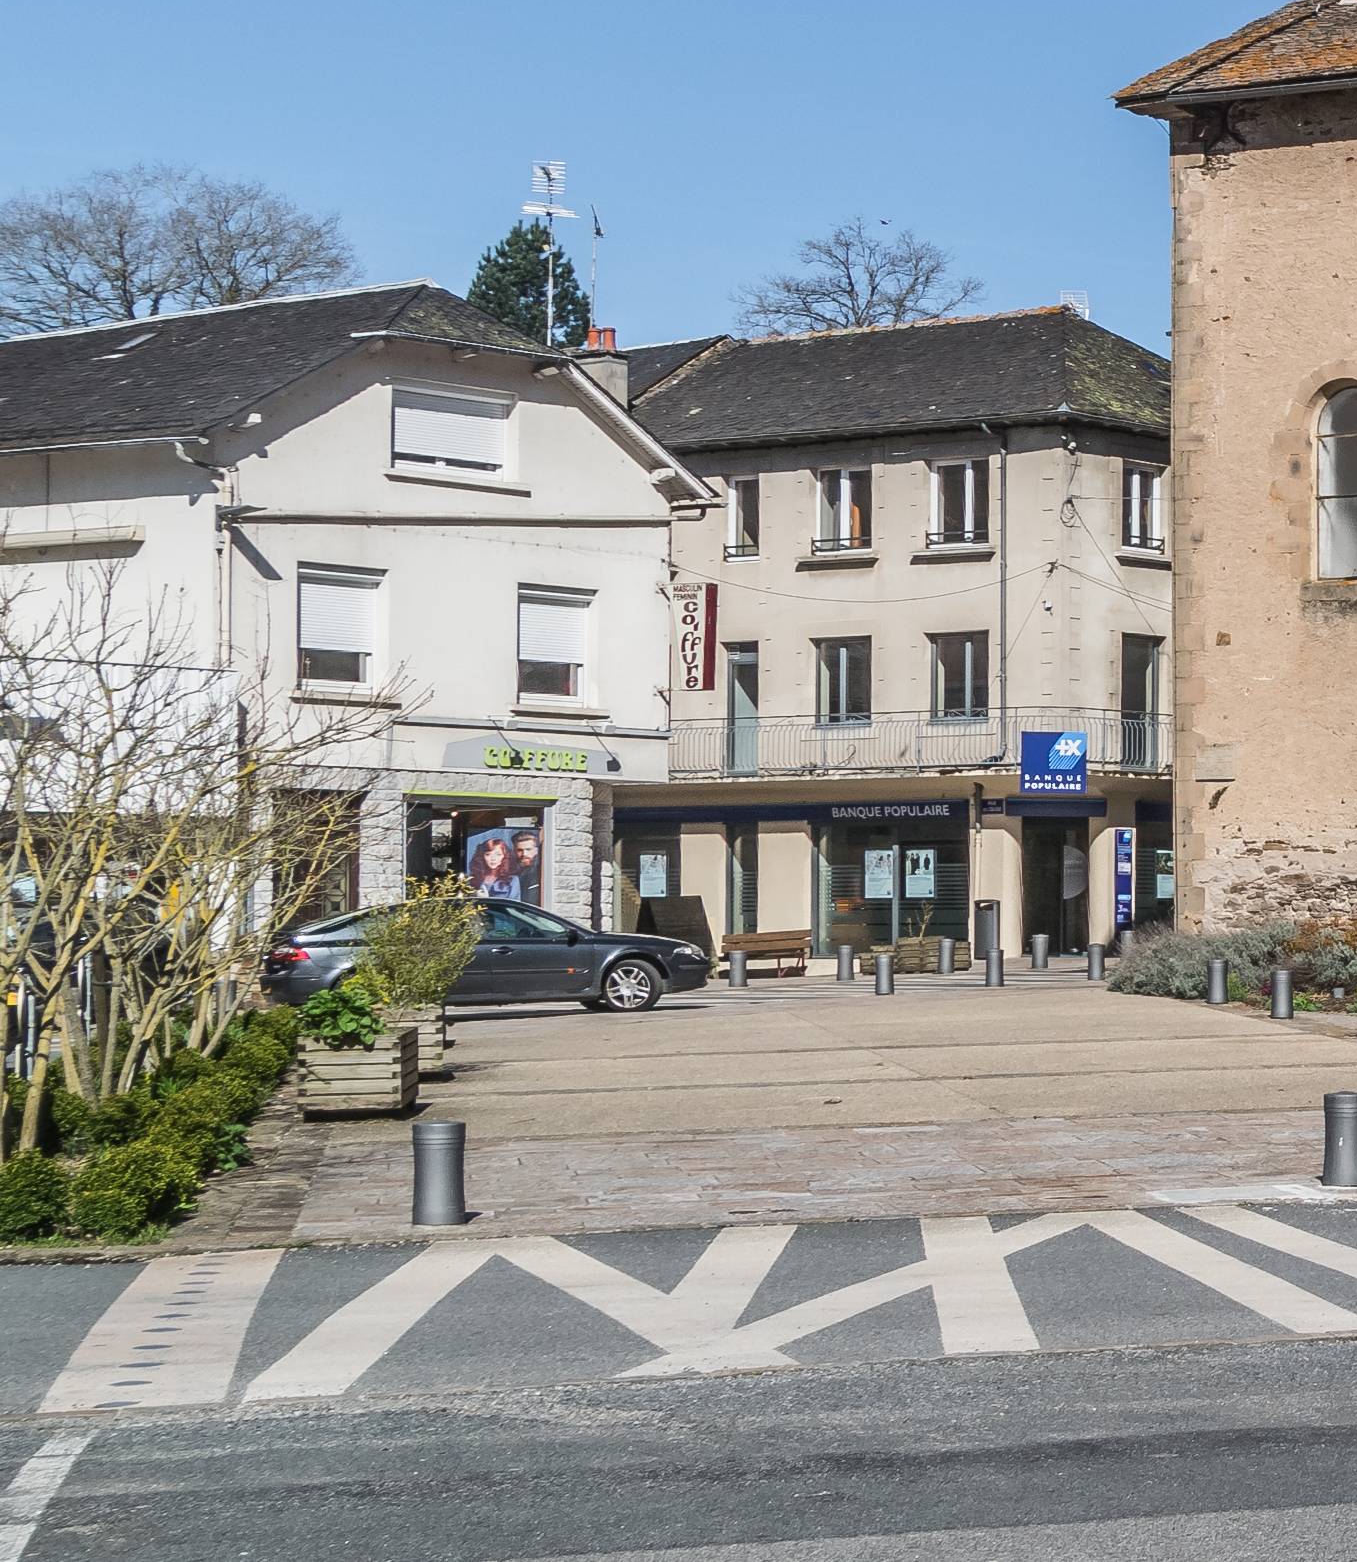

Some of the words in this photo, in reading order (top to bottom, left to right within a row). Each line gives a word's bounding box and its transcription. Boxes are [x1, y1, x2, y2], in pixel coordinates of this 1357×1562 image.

[484, 746, 588, 773] COFFURE
[1024, 774, 1081, 782] BANQUE
[1024, 782, 1082, 790] POPULAIRE
[832, 807, 882, 818] BANQUE
[884, 805, 950, 816] POPULAIRE
